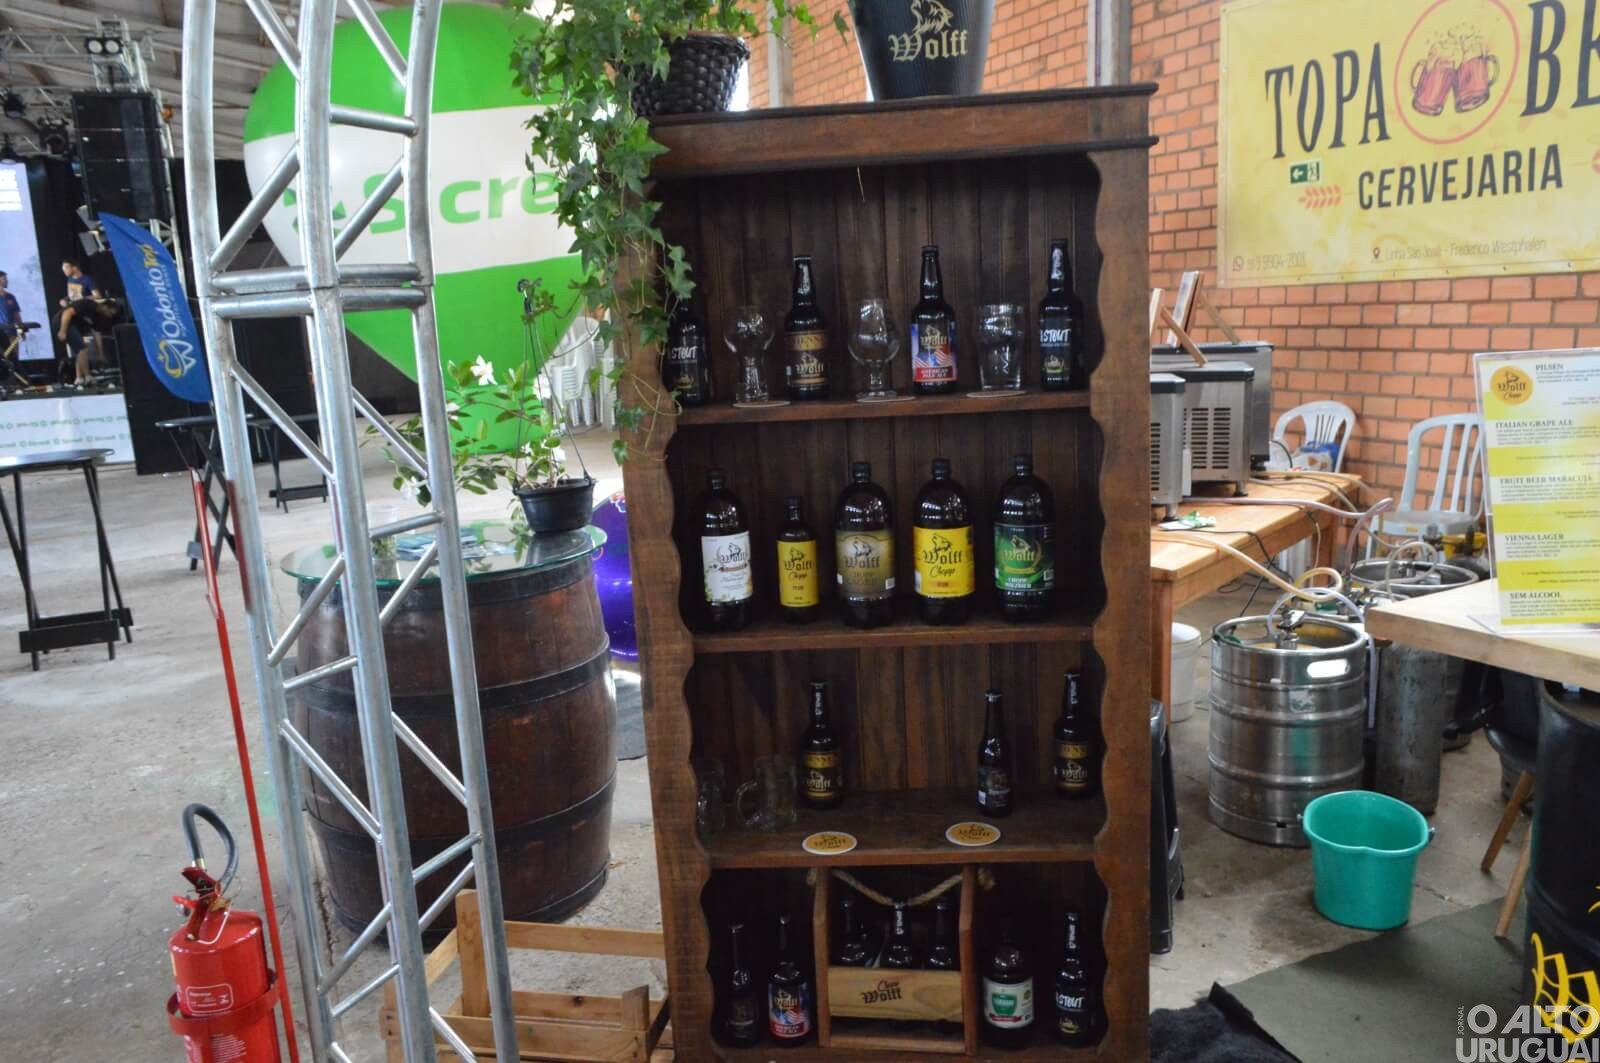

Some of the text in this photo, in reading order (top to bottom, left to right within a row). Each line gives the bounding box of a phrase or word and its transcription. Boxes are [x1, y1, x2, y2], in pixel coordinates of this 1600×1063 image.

[888, 29, 968, 61] Wolff
[1265, 41, 1391, 159] TOPA
[1358, 143, 1563, 210] CERVEJARIA
[1535, 363, 1564, 371] PILSEN
[1495, 421, 1528, 429] ITALIAN
[1529, 419, 1556, 428] GRAPE
[1537, 533, 1564, 541] LAGER
[922, 550, 963, 565] Wolff
[1510, 592, 1528, 600] SEM
